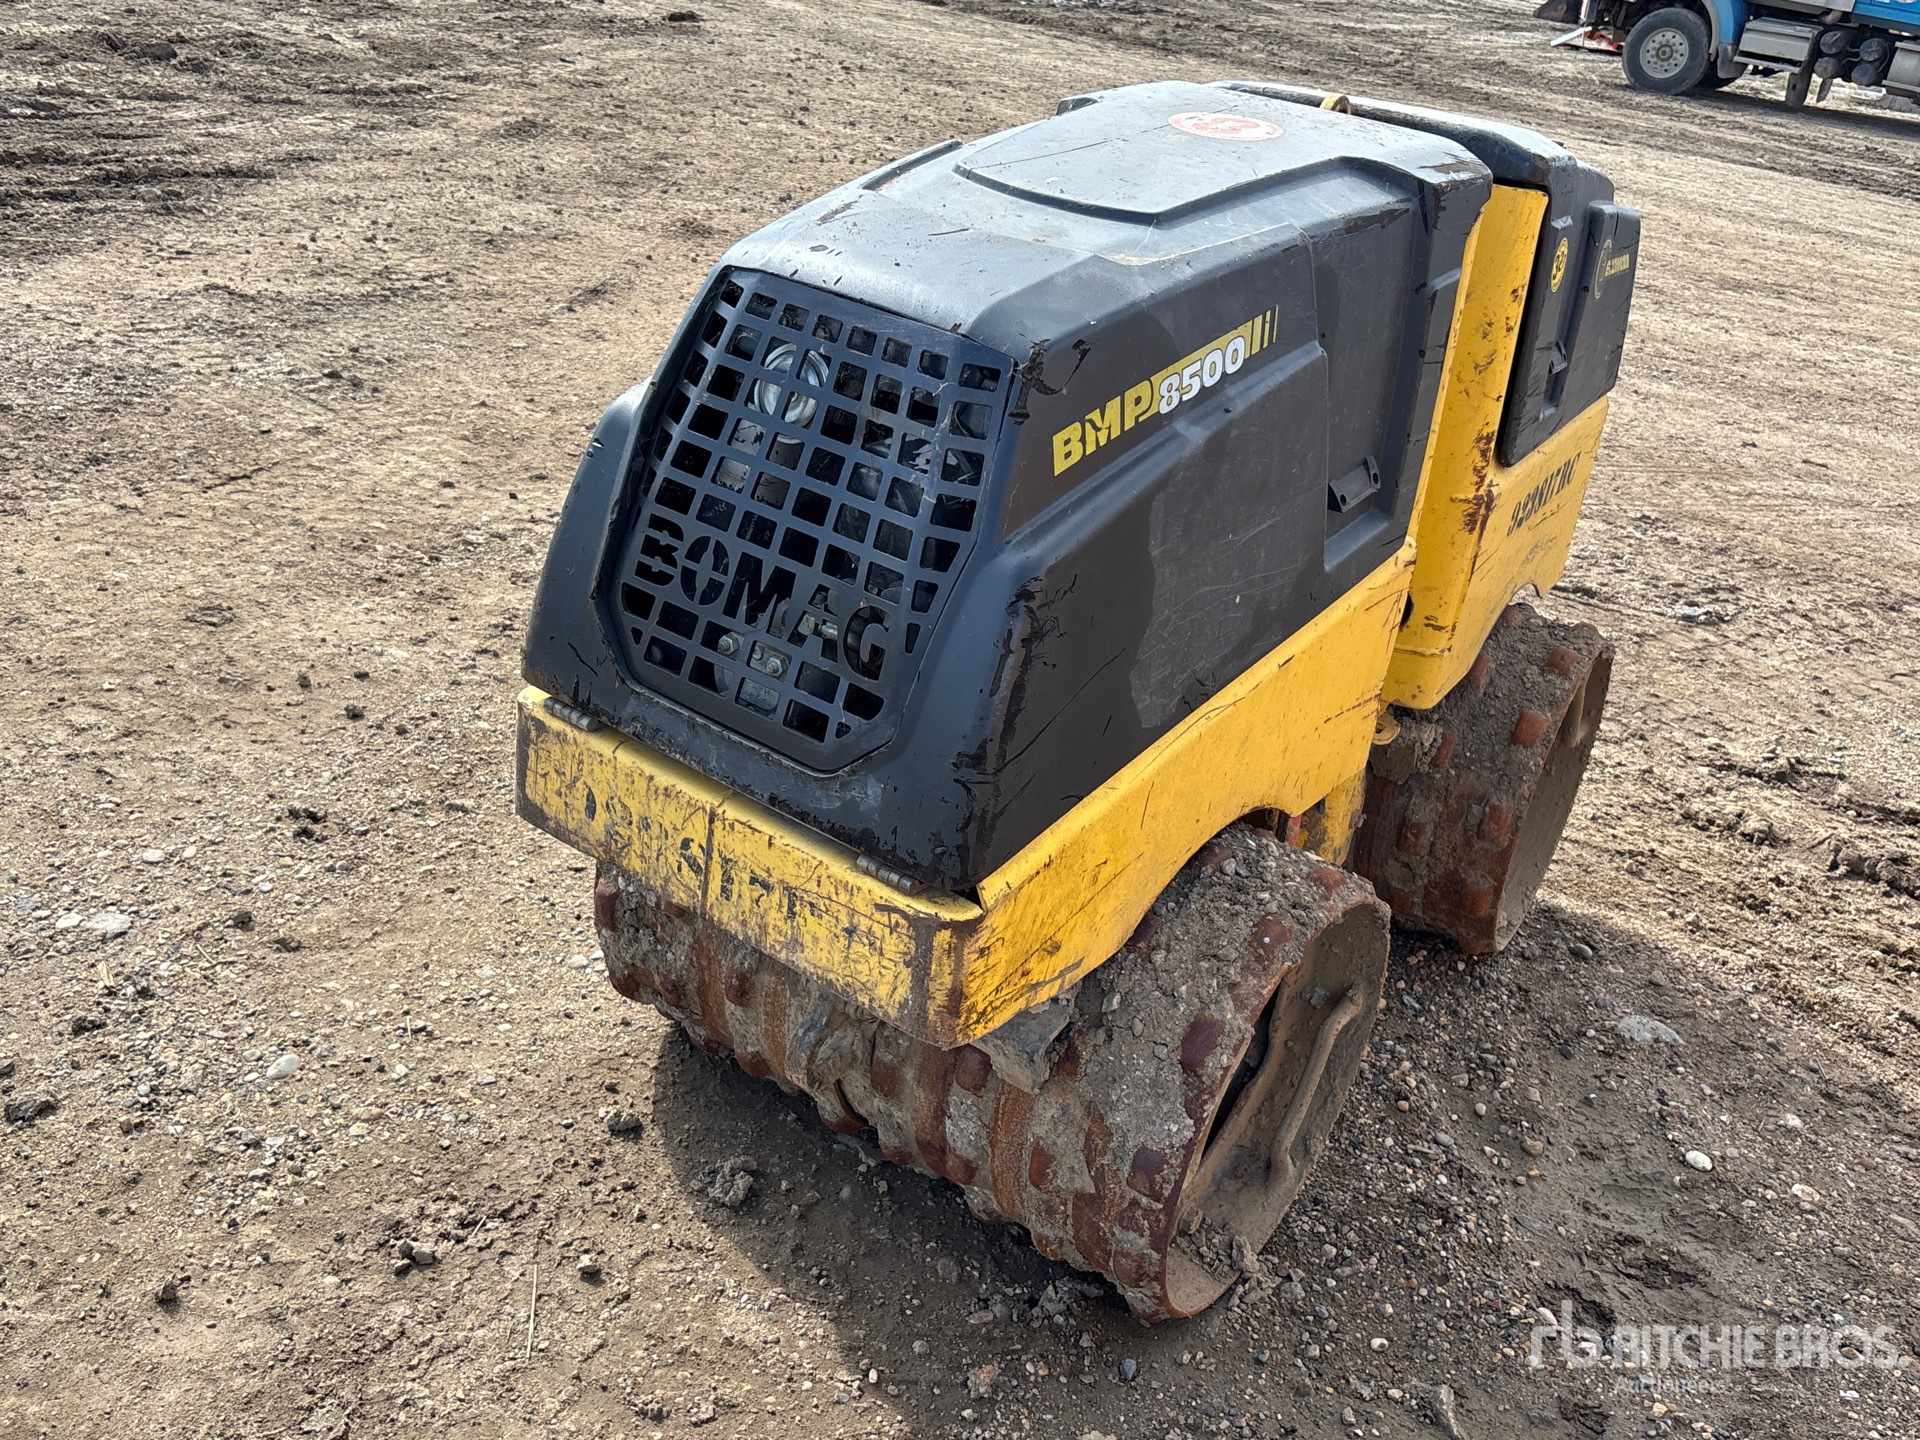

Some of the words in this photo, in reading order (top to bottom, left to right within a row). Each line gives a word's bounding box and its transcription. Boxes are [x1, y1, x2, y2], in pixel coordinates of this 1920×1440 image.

[1052, 379, 1153, 477] BMP
[1158, 335, 1246, 415] 8500
[633, 512, 894, 682] BOMAG
